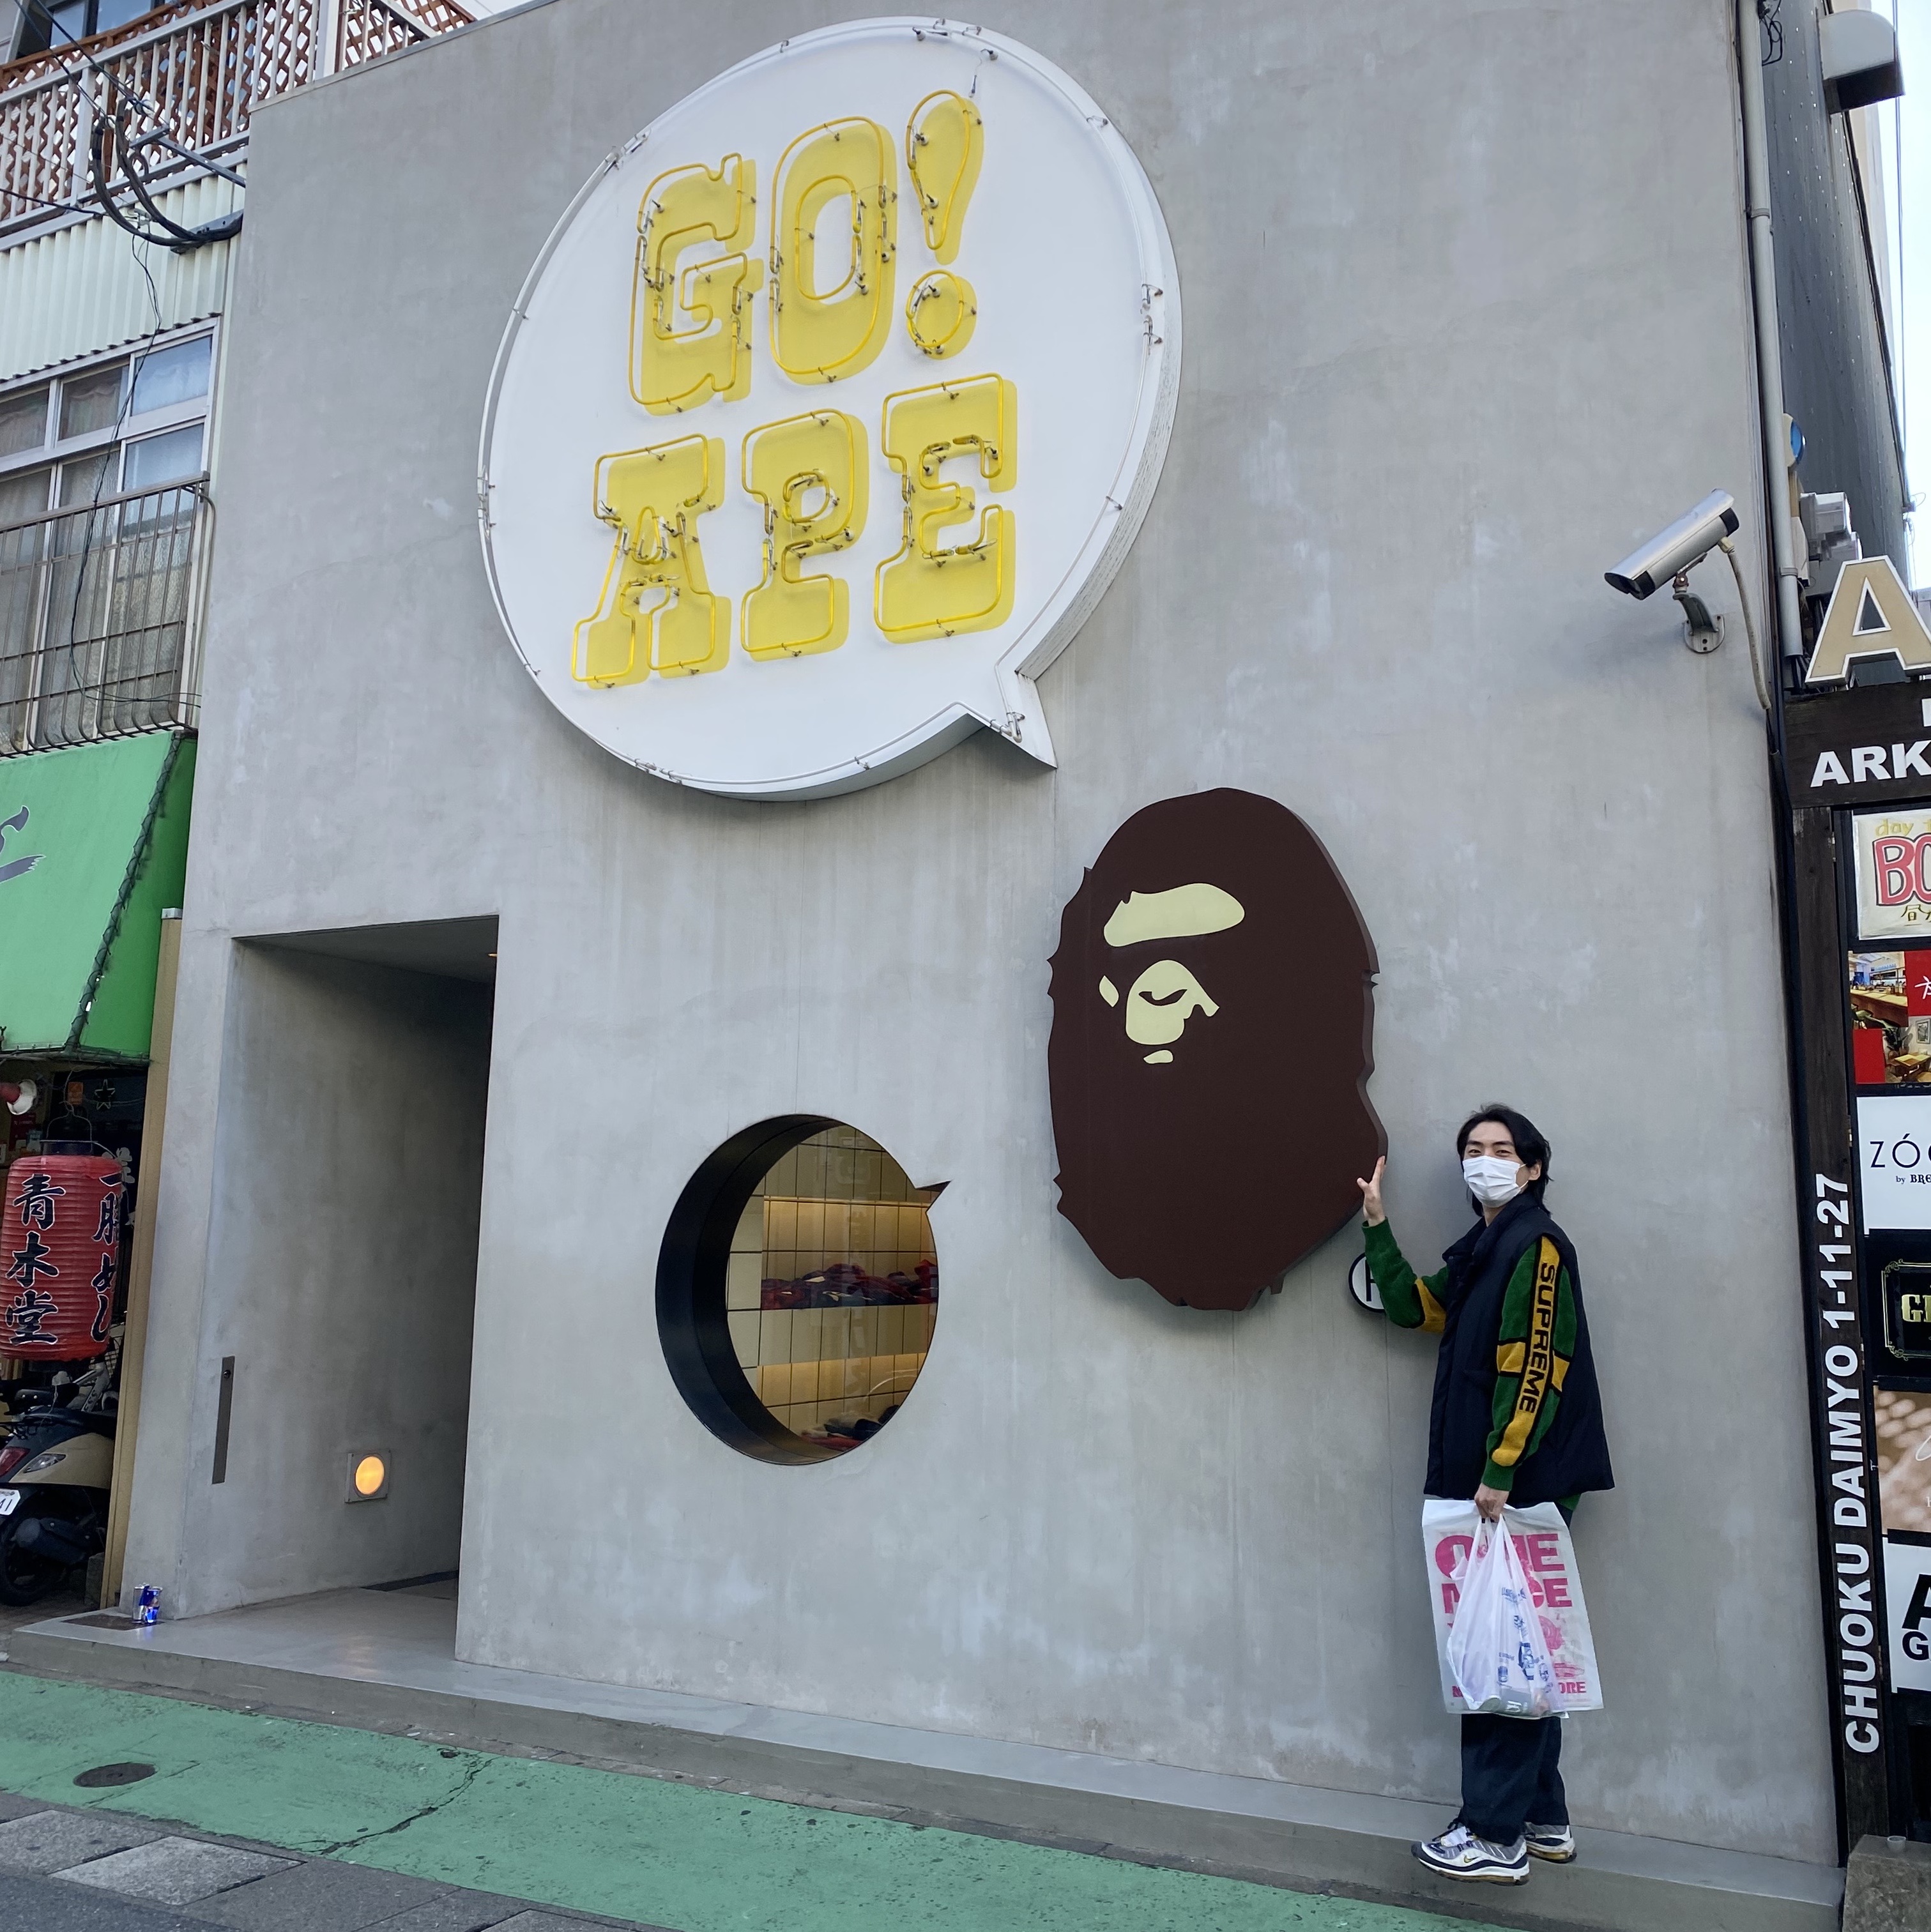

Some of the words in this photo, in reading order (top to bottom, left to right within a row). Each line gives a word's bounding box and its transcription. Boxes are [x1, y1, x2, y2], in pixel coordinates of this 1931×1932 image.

[629, 90, 984, 416] GO!
[572, 372, 1017, 690] APE
[1875, 818, 1914, 836] day
[1870, 1133, 1931, 1168] ZÓ
[1895, 1175, 1906, 1185] by
[5, 1173, 66, 1345] 青木堂
[1815, 1173, 1855, 1329] 1-11-27
[1519, 1261, 1556, 1414] SUPREME
[1824, 1345, 1867, 1528] DAIMYO
[1835, 1542, 1880, 1753] CHUOKU
